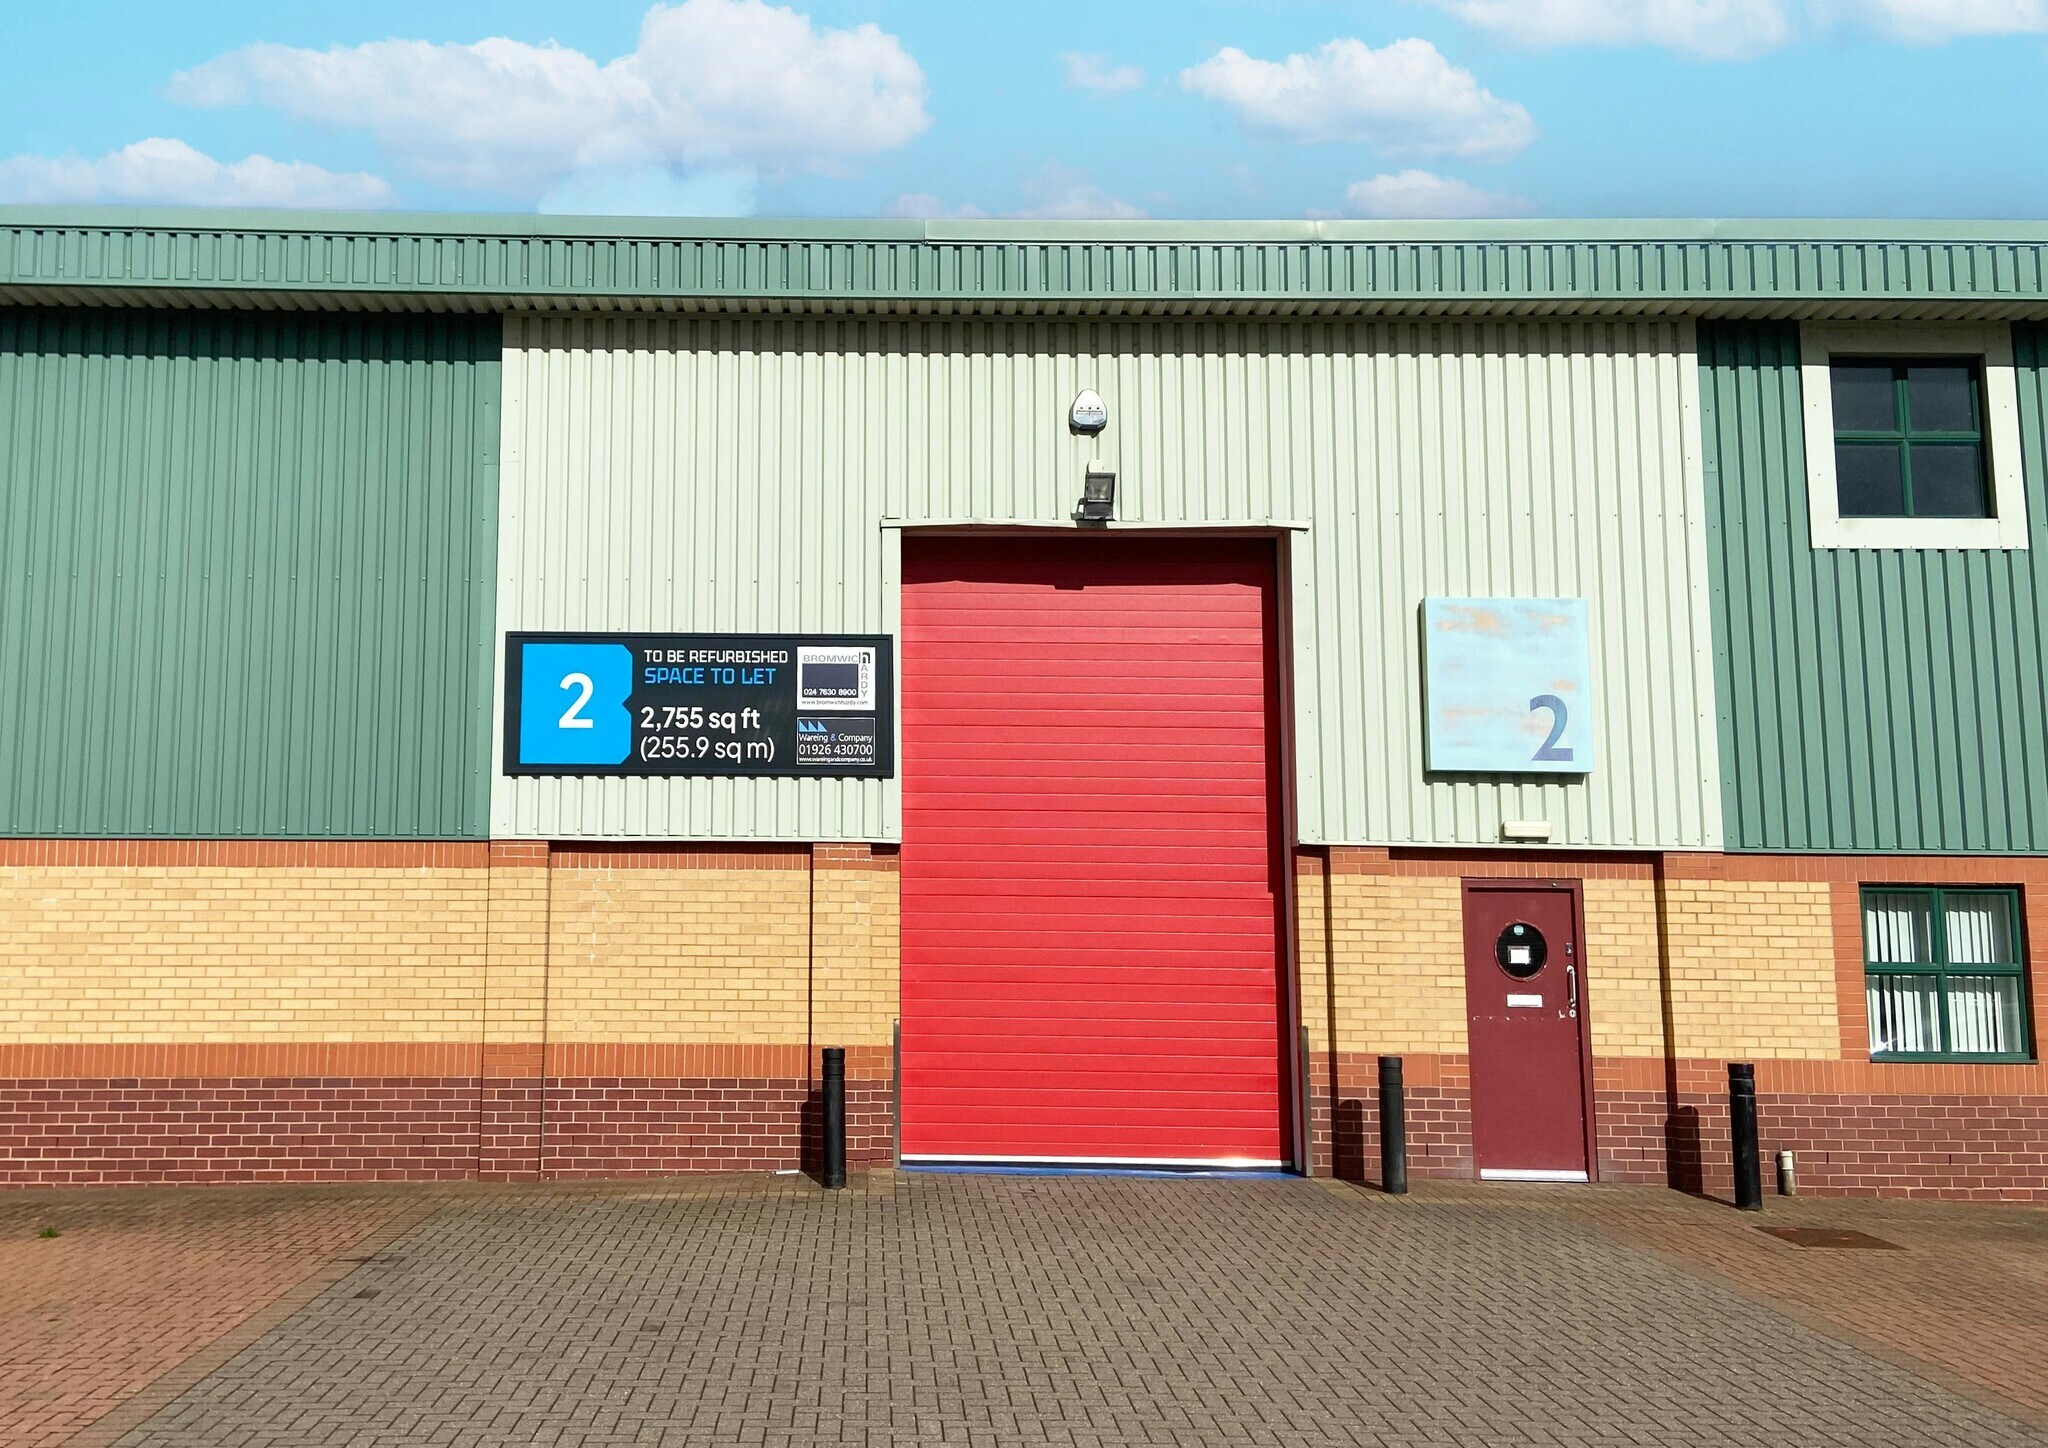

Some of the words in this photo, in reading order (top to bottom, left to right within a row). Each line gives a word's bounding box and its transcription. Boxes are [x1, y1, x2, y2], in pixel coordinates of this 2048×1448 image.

[644, 650, 662, 663] TO
[667, 650, 685, 663] BE
[689, 650, 788, 664] REFURBISHED
[644, 667, 705, 685] SPACE
[710, 667, 735, 685] TO
[741, 667, 777, 685] LET
[558, 672, 594, 729] 2
[803, 688, 817, 696] 024
[819, 688, 836, 696] 7630
[838, 688, 857, 696] 8900
[640, 706, 704, 732] 2,755
[708, 711, 736, 734] sq
[741, 707, 761, 730] ft
[1529, 694, 1574, 762] 2
[798, 733, 829, 743] Wareing
[830, 733, 836, 742] &
[838, 733, 873, 744] Company
[640, 735, 709, 762] (255.9
[714, 741, 741, 764] sq
[747, 736, 775, 763] m)
[798, 744, 832, 755] 01926
[833, 744, 873, 755] 430700
